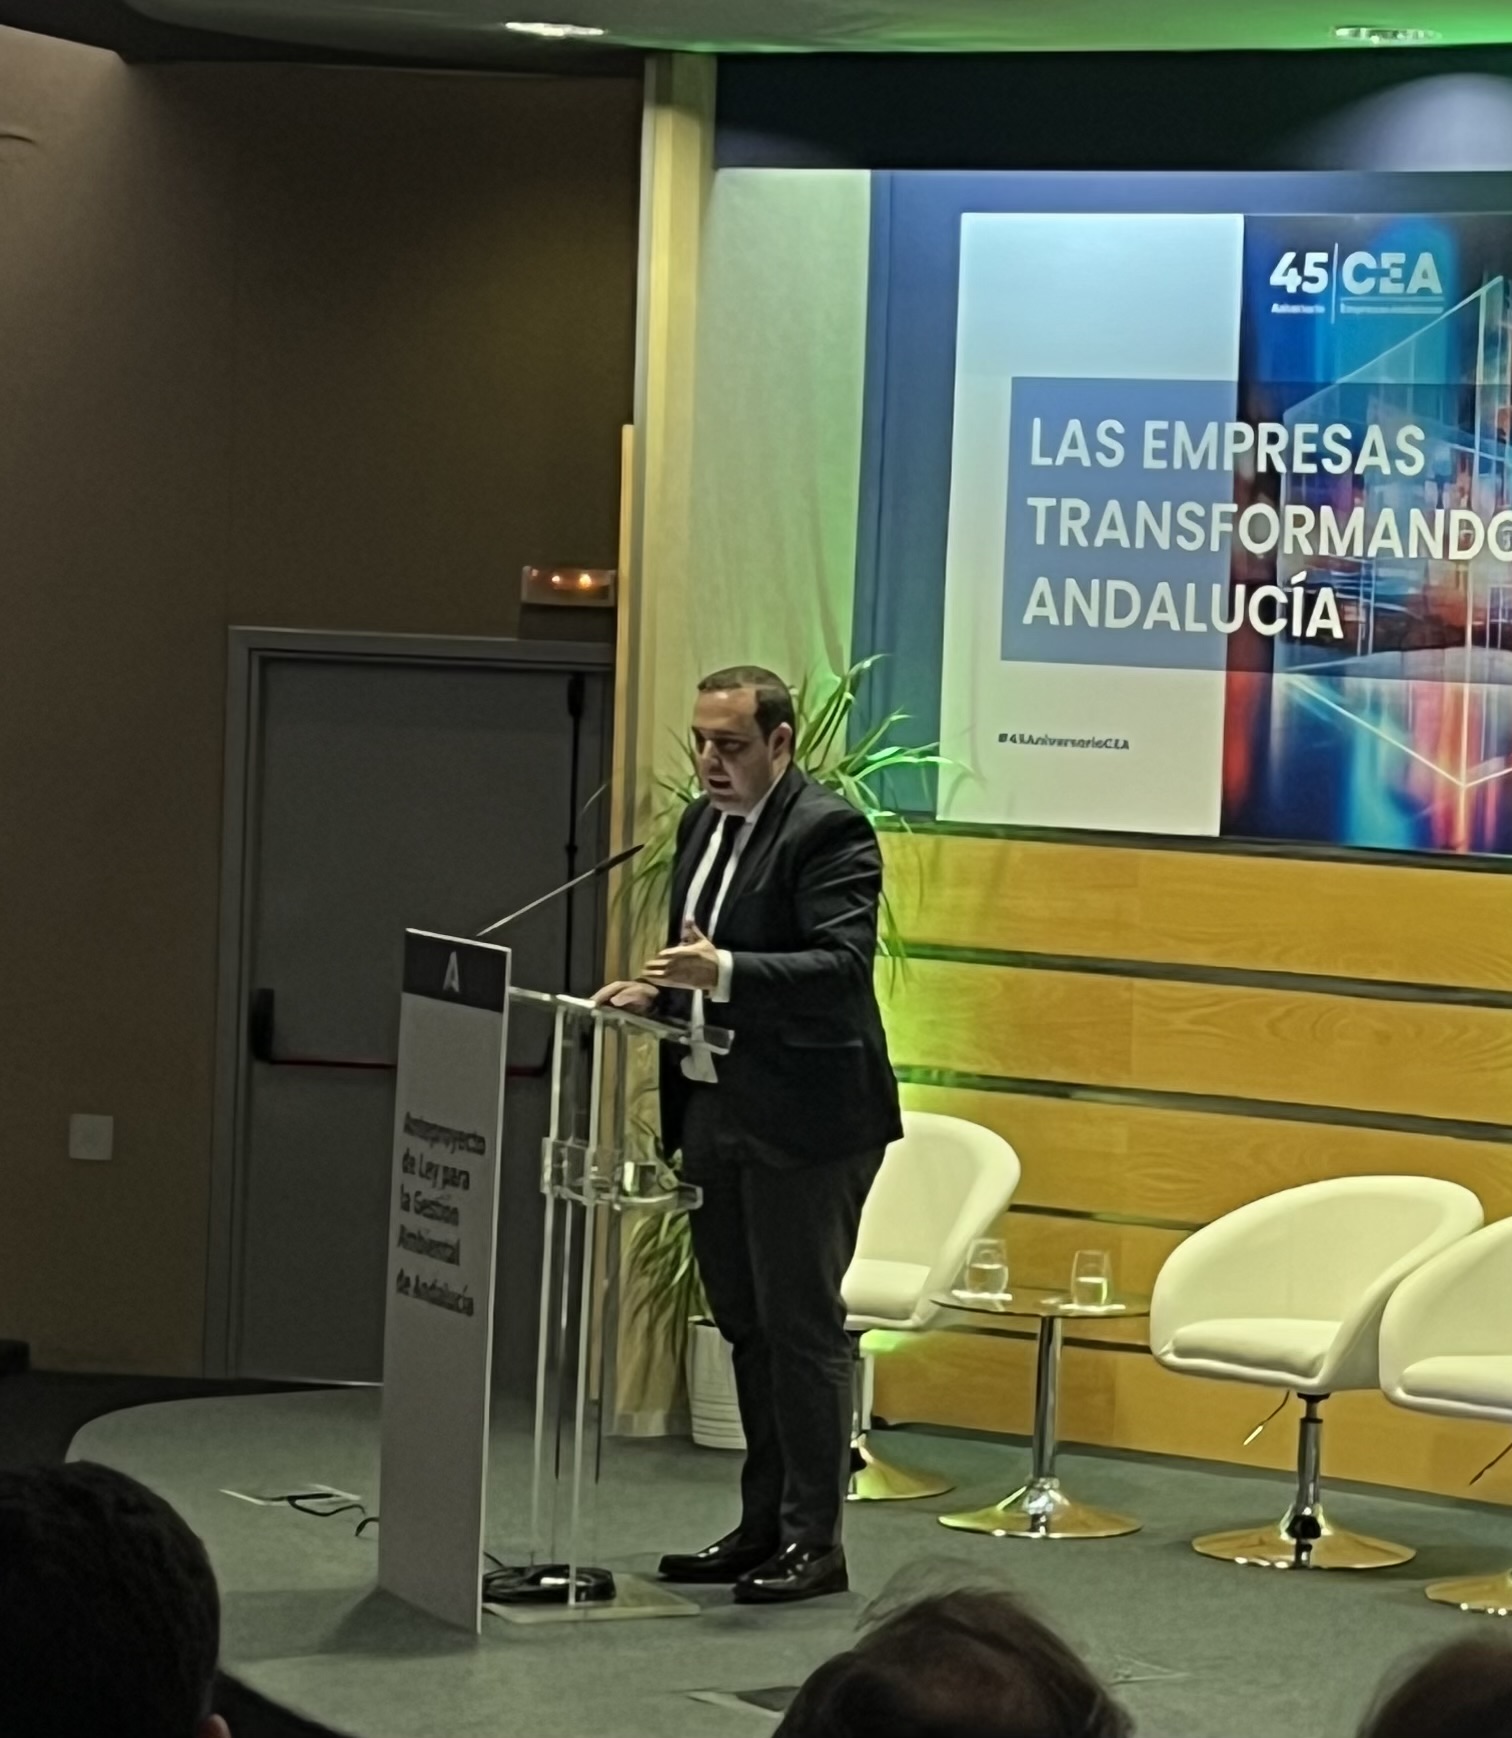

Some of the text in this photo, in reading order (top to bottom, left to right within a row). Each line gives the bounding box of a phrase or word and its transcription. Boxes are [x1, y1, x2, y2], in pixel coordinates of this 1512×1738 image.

[1269, 250, 1443, 295] 45 CEA
[1030, 417, 1426, 477] LAS EMPRESAS
[1021, 570, 1344, 639] ANDALUCÍA
[419, 1153, 439, 1189] Ley
